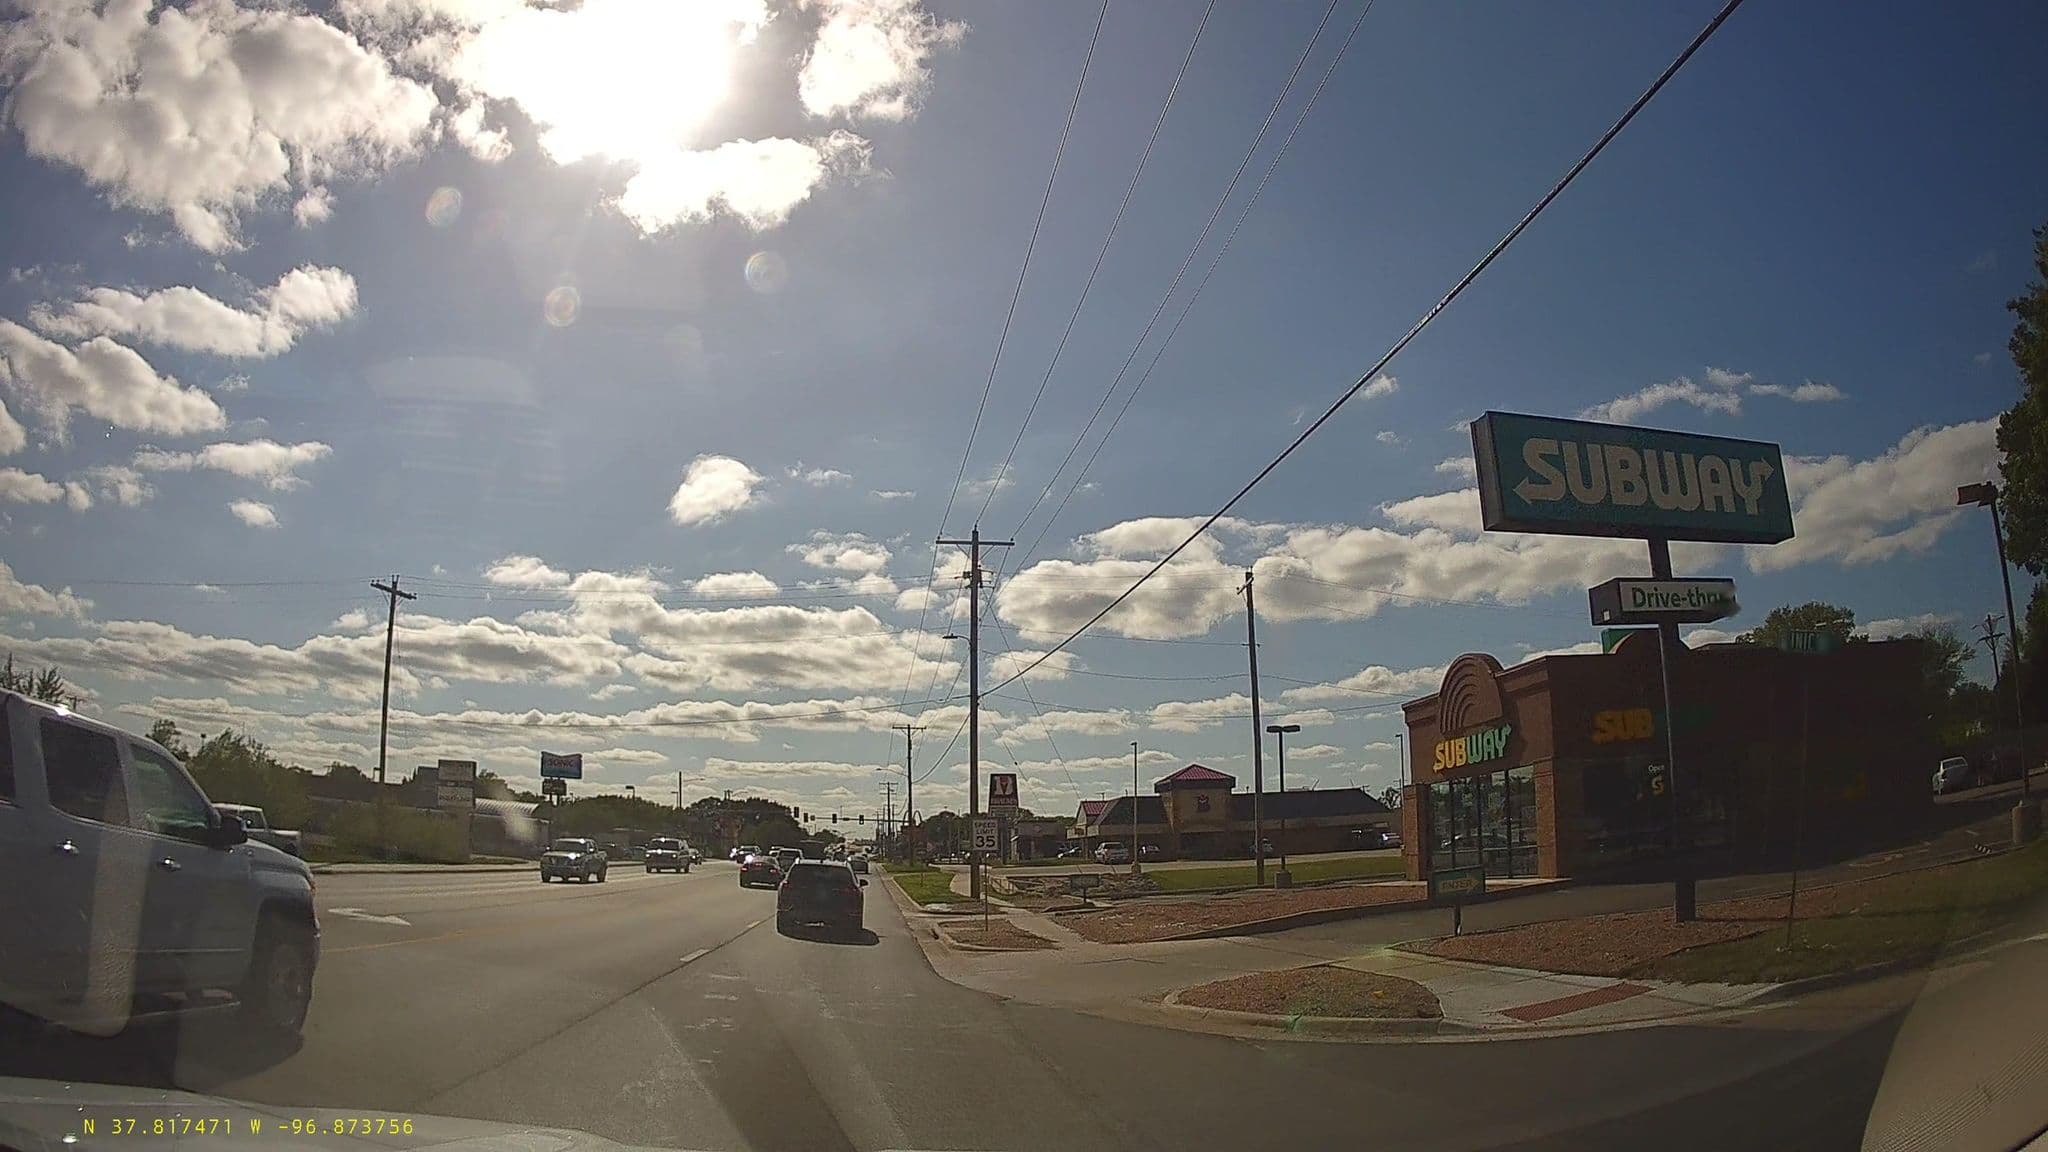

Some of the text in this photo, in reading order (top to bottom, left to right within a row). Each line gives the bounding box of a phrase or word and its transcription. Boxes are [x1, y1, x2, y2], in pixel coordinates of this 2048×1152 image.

[1513, 437, 1775, 515] SUBWAY
[1432, 723, 1512, 773] SUBWAY
[975, 835, 996, 848] 35
